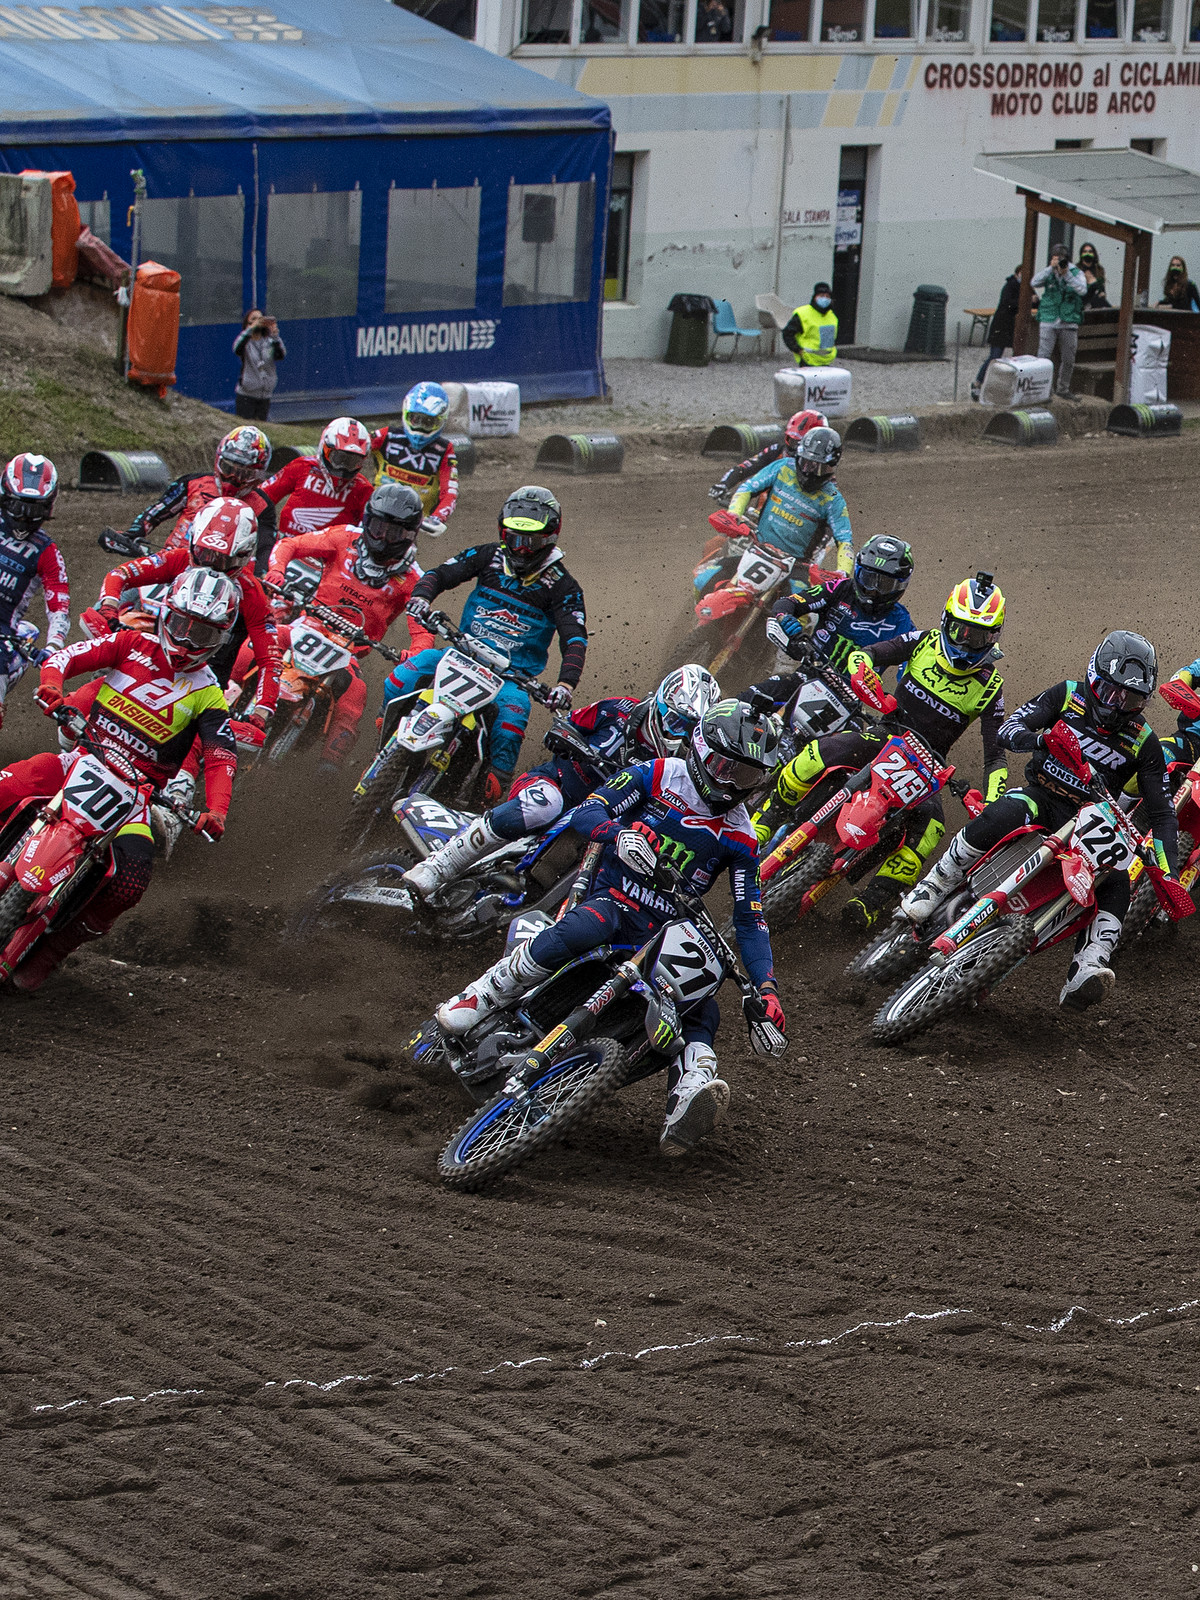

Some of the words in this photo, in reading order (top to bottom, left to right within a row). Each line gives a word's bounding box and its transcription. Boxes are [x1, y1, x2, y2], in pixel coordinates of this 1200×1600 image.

[924, 62, 1084, 89] CROSSODROMO
[1093, 62, 1110, 87] al
[991, 92, 1043, 116] MOTO
[1052, 91, 1099, 115] CLUB
[1107, 91, 1156, 114] ARCO
[356, 321, 469, 358] MARANGONI
[385, 442, 442, 473] FXR
[303, 474, 352, 503] KENNY
[770, 505, 804, 528] JUMBO
[0, 532, 39, 560] HOT
[742, 560, 774, 585] 6
[340, 583, 374, 607] HITACHI
[293, 633, 344, 670] 811
[438, 666, 493, 708] 777
[856, 679, 883, 709] ACERBIS
[904, 680, 962, 724] HONDA
[107, 694, 174, 742] ANSWER
[95, 714, 159, 763] HONDA
[904, 736, 944, 776] RENTHAL
[871, 751, 931, 805] 243
[63, 769, 133, 832] 201
[410, 800, 459, 831] 147
[611, 789, 642, 817] YAMAHA
[659, 789, 687, 812] WILVO
[813, 789, 848, 824] SHOWA
[1074, 813, 1129, 870] 128
[621, 875, 678, 918] YAMAH
[697, 936, 716, 964] YAMAHA
[658, 941, 720, 998] 21
